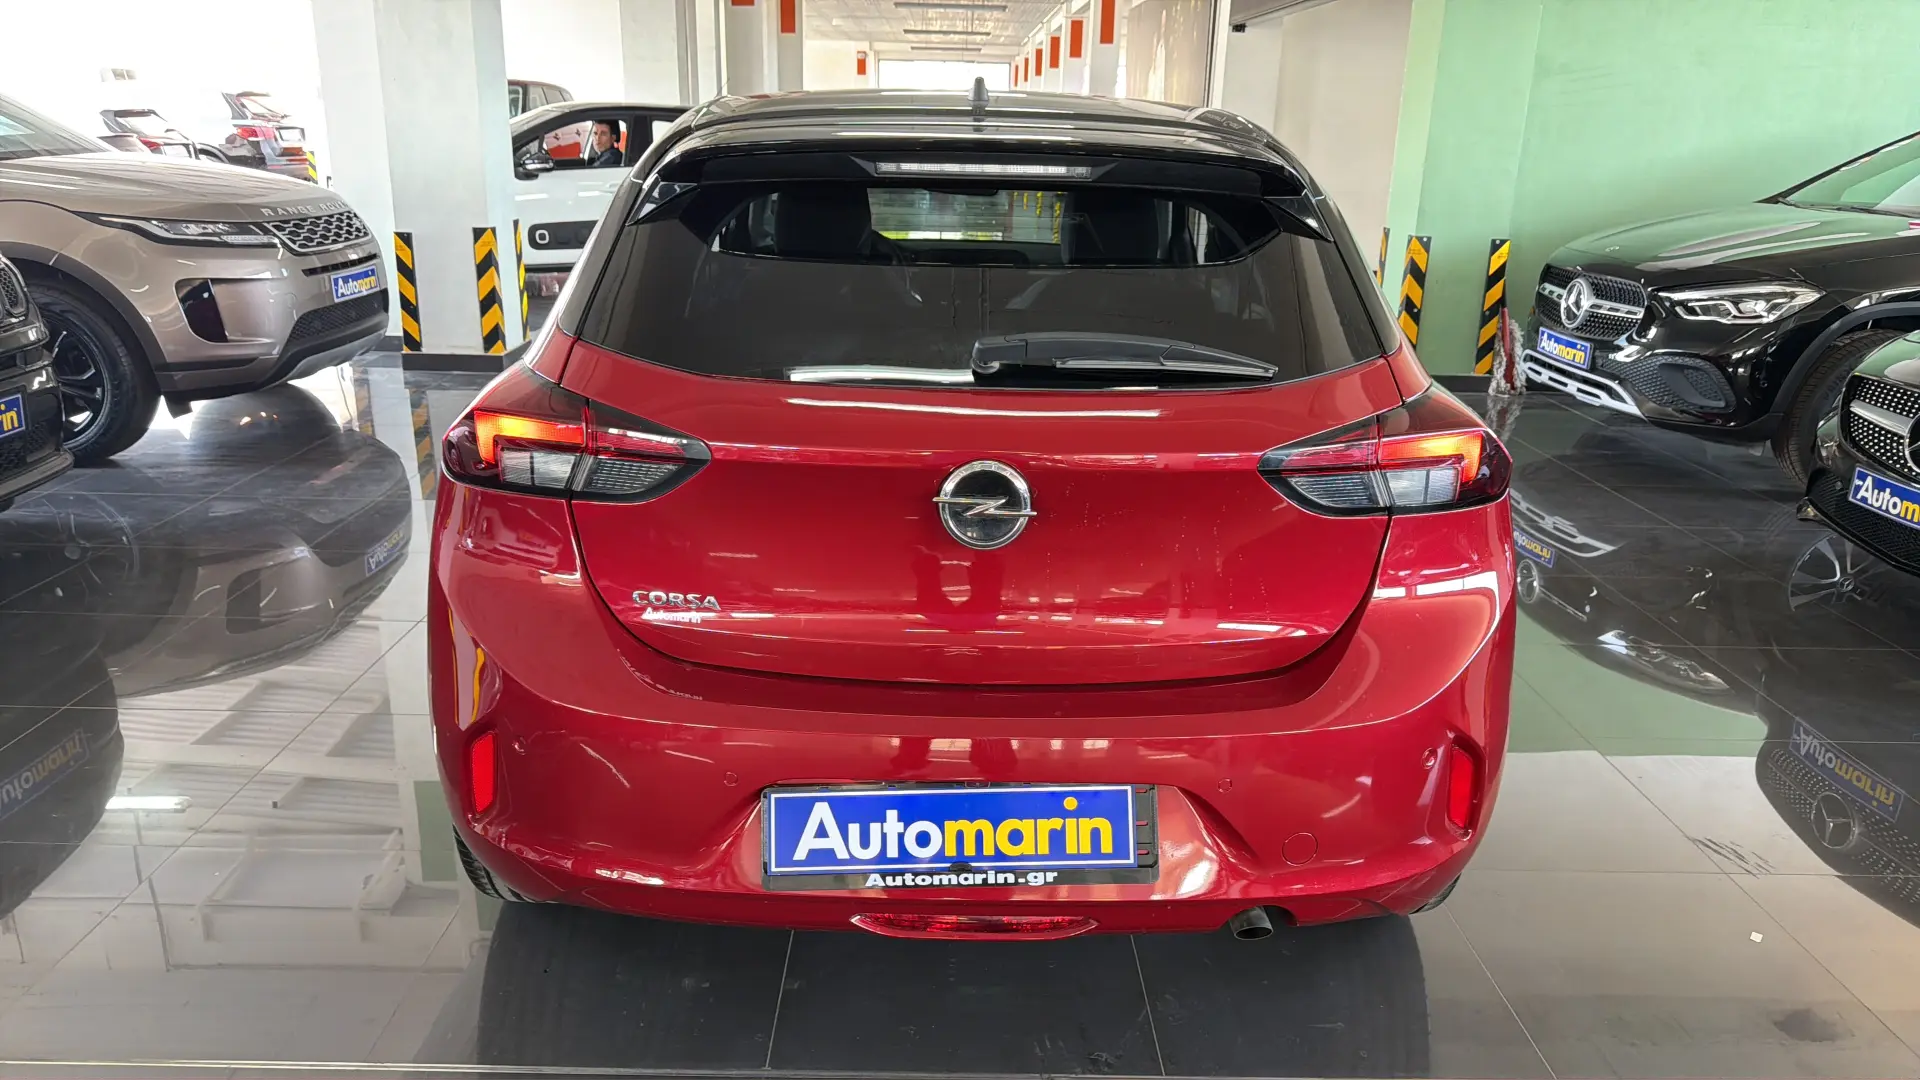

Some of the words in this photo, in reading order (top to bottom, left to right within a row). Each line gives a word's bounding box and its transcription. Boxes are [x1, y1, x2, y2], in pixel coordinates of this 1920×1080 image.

[260, 205, 316, 217] RANGE
[319, 200, 346, 212] ROV
[337, 270, 377, 297] Automarin
[1540, 332, 1586, 365] Automarin
[1856, 475, 1920, 523] Autom
[632, 590, 722, 611] CORSA
[641, 606, 702, 624] Automarin
[792, 796, 1113, 861] Automarin
[865, 870, 1058, 886] Automarin.gr
